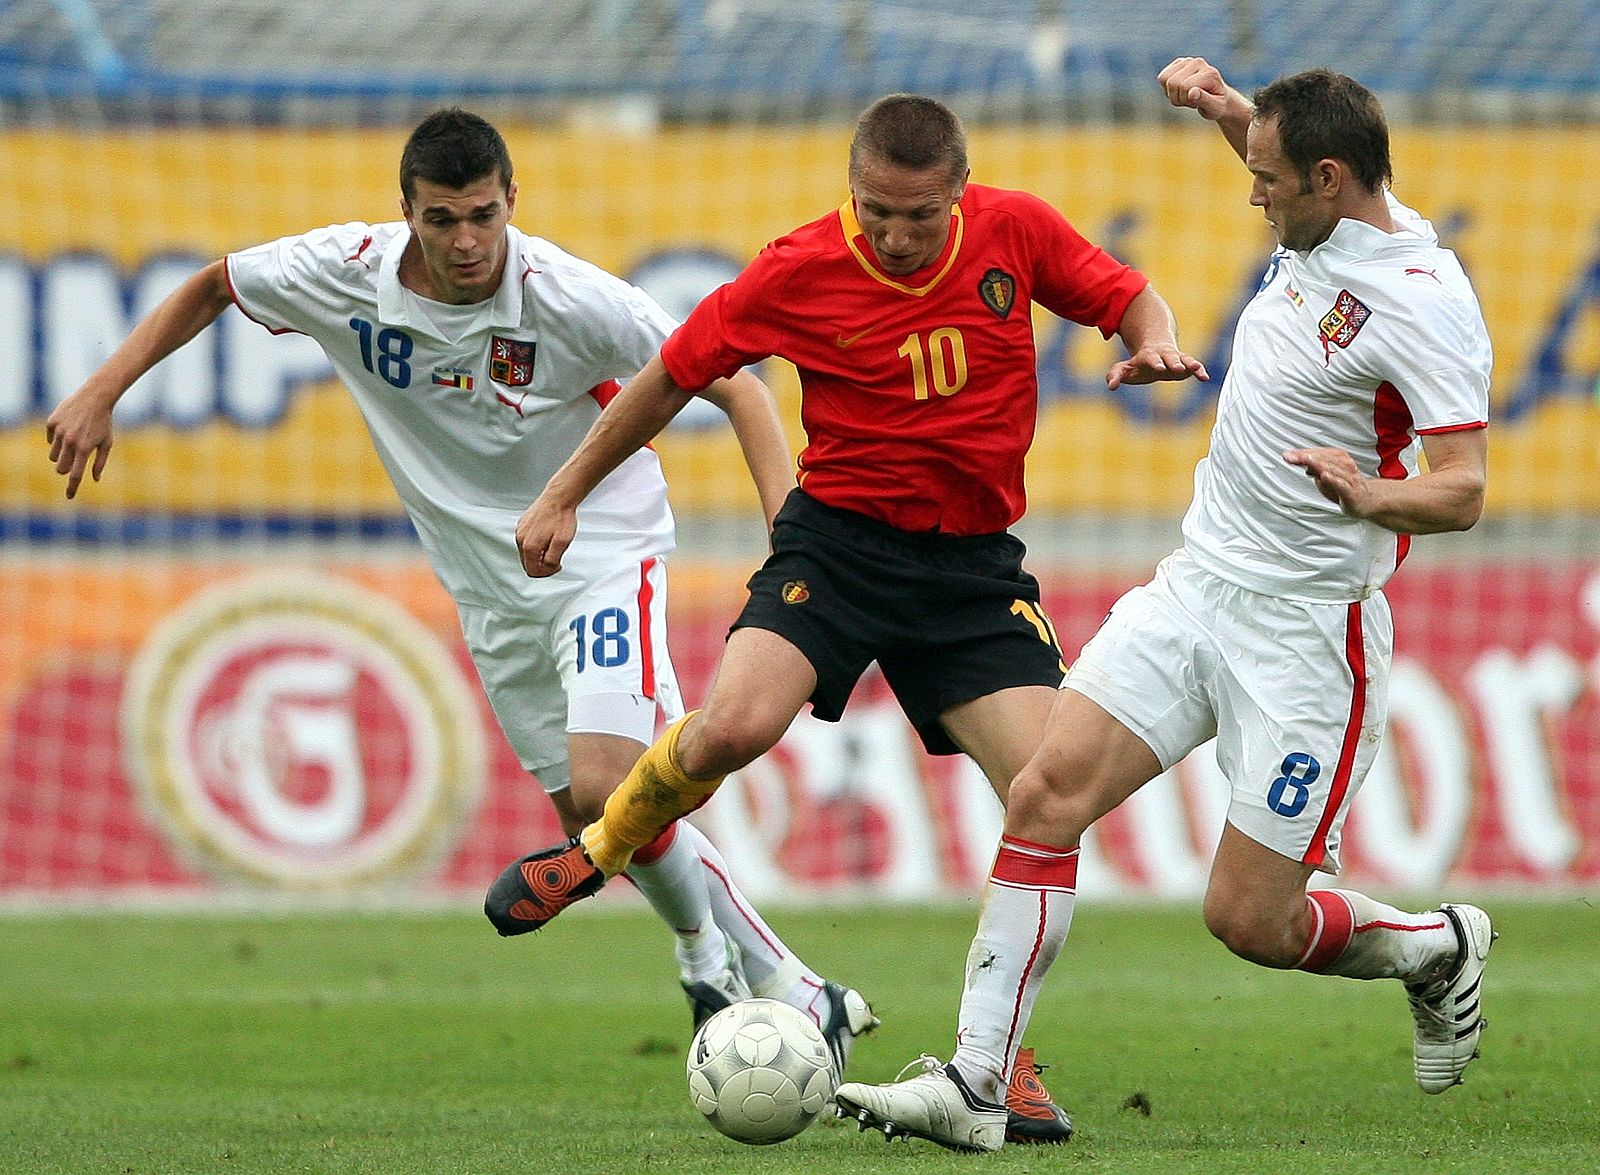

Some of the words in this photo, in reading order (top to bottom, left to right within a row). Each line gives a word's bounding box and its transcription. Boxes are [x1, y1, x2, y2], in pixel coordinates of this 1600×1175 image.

[349, 317, 413, 389] 18
[898, 327, 967, 400] 10
[569, 607, 629, 674] 18
[1267, 752, 1320, 818] 8
